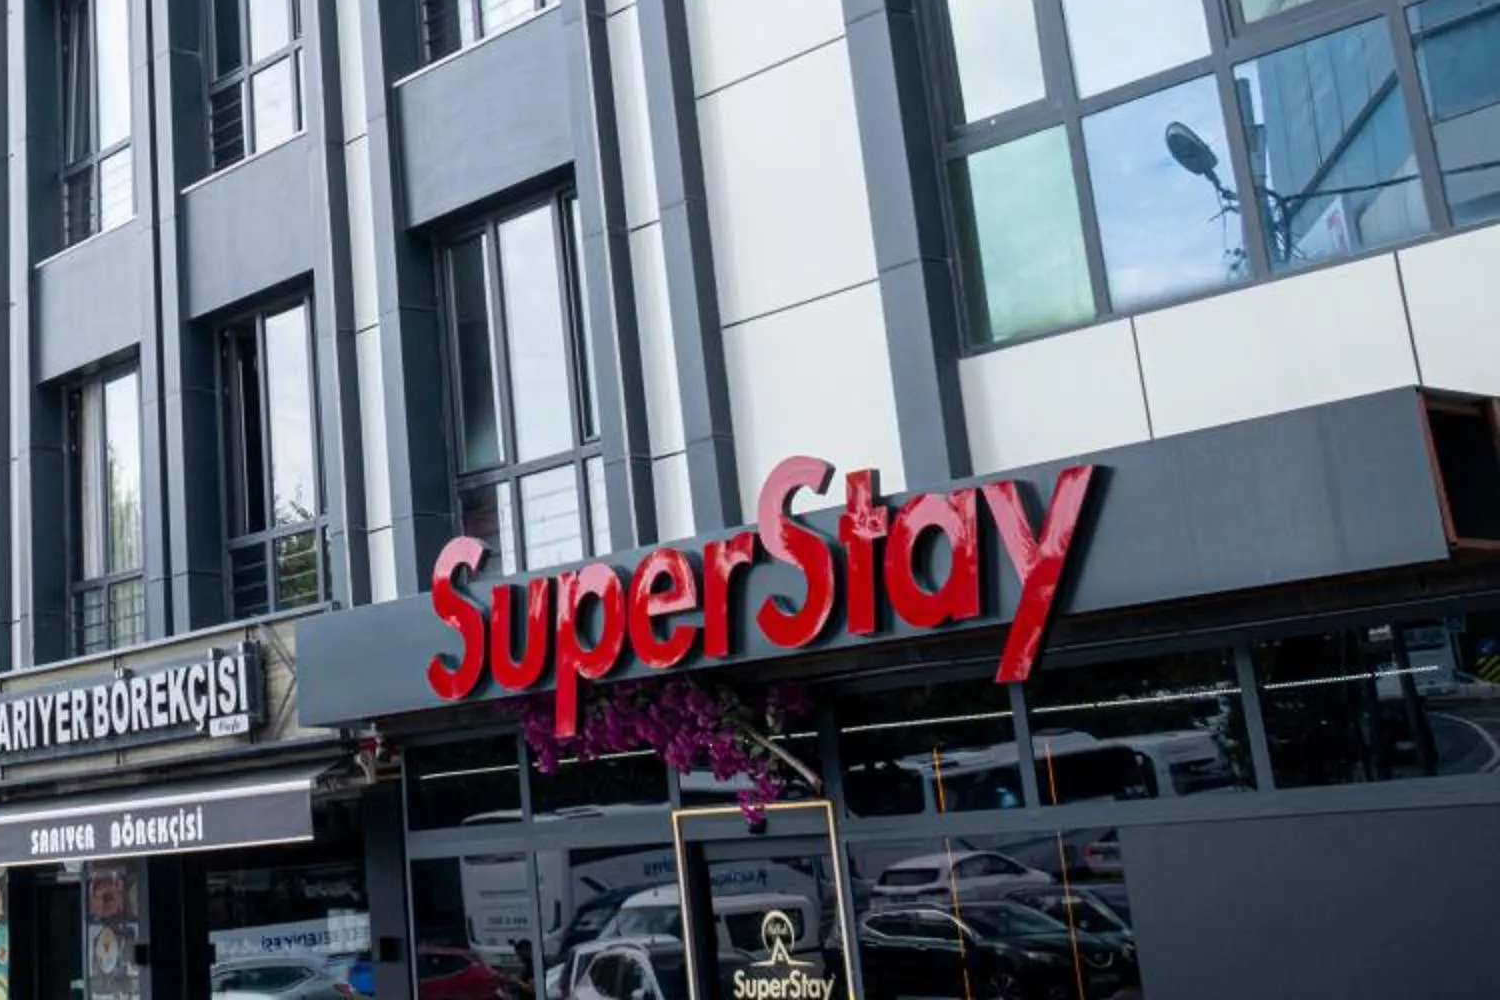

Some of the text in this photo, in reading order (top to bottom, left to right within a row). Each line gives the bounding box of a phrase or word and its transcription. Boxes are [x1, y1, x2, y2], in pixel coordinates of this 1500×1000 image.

[426, 455, 1097, 737] SuperStay
[92, 642, 248, 733] BÖREKÇİSİ
[31, 806, 204, 855] SARIYER BÖREKÇİSİ
[732, 968, 834, 1000] SuperStay
